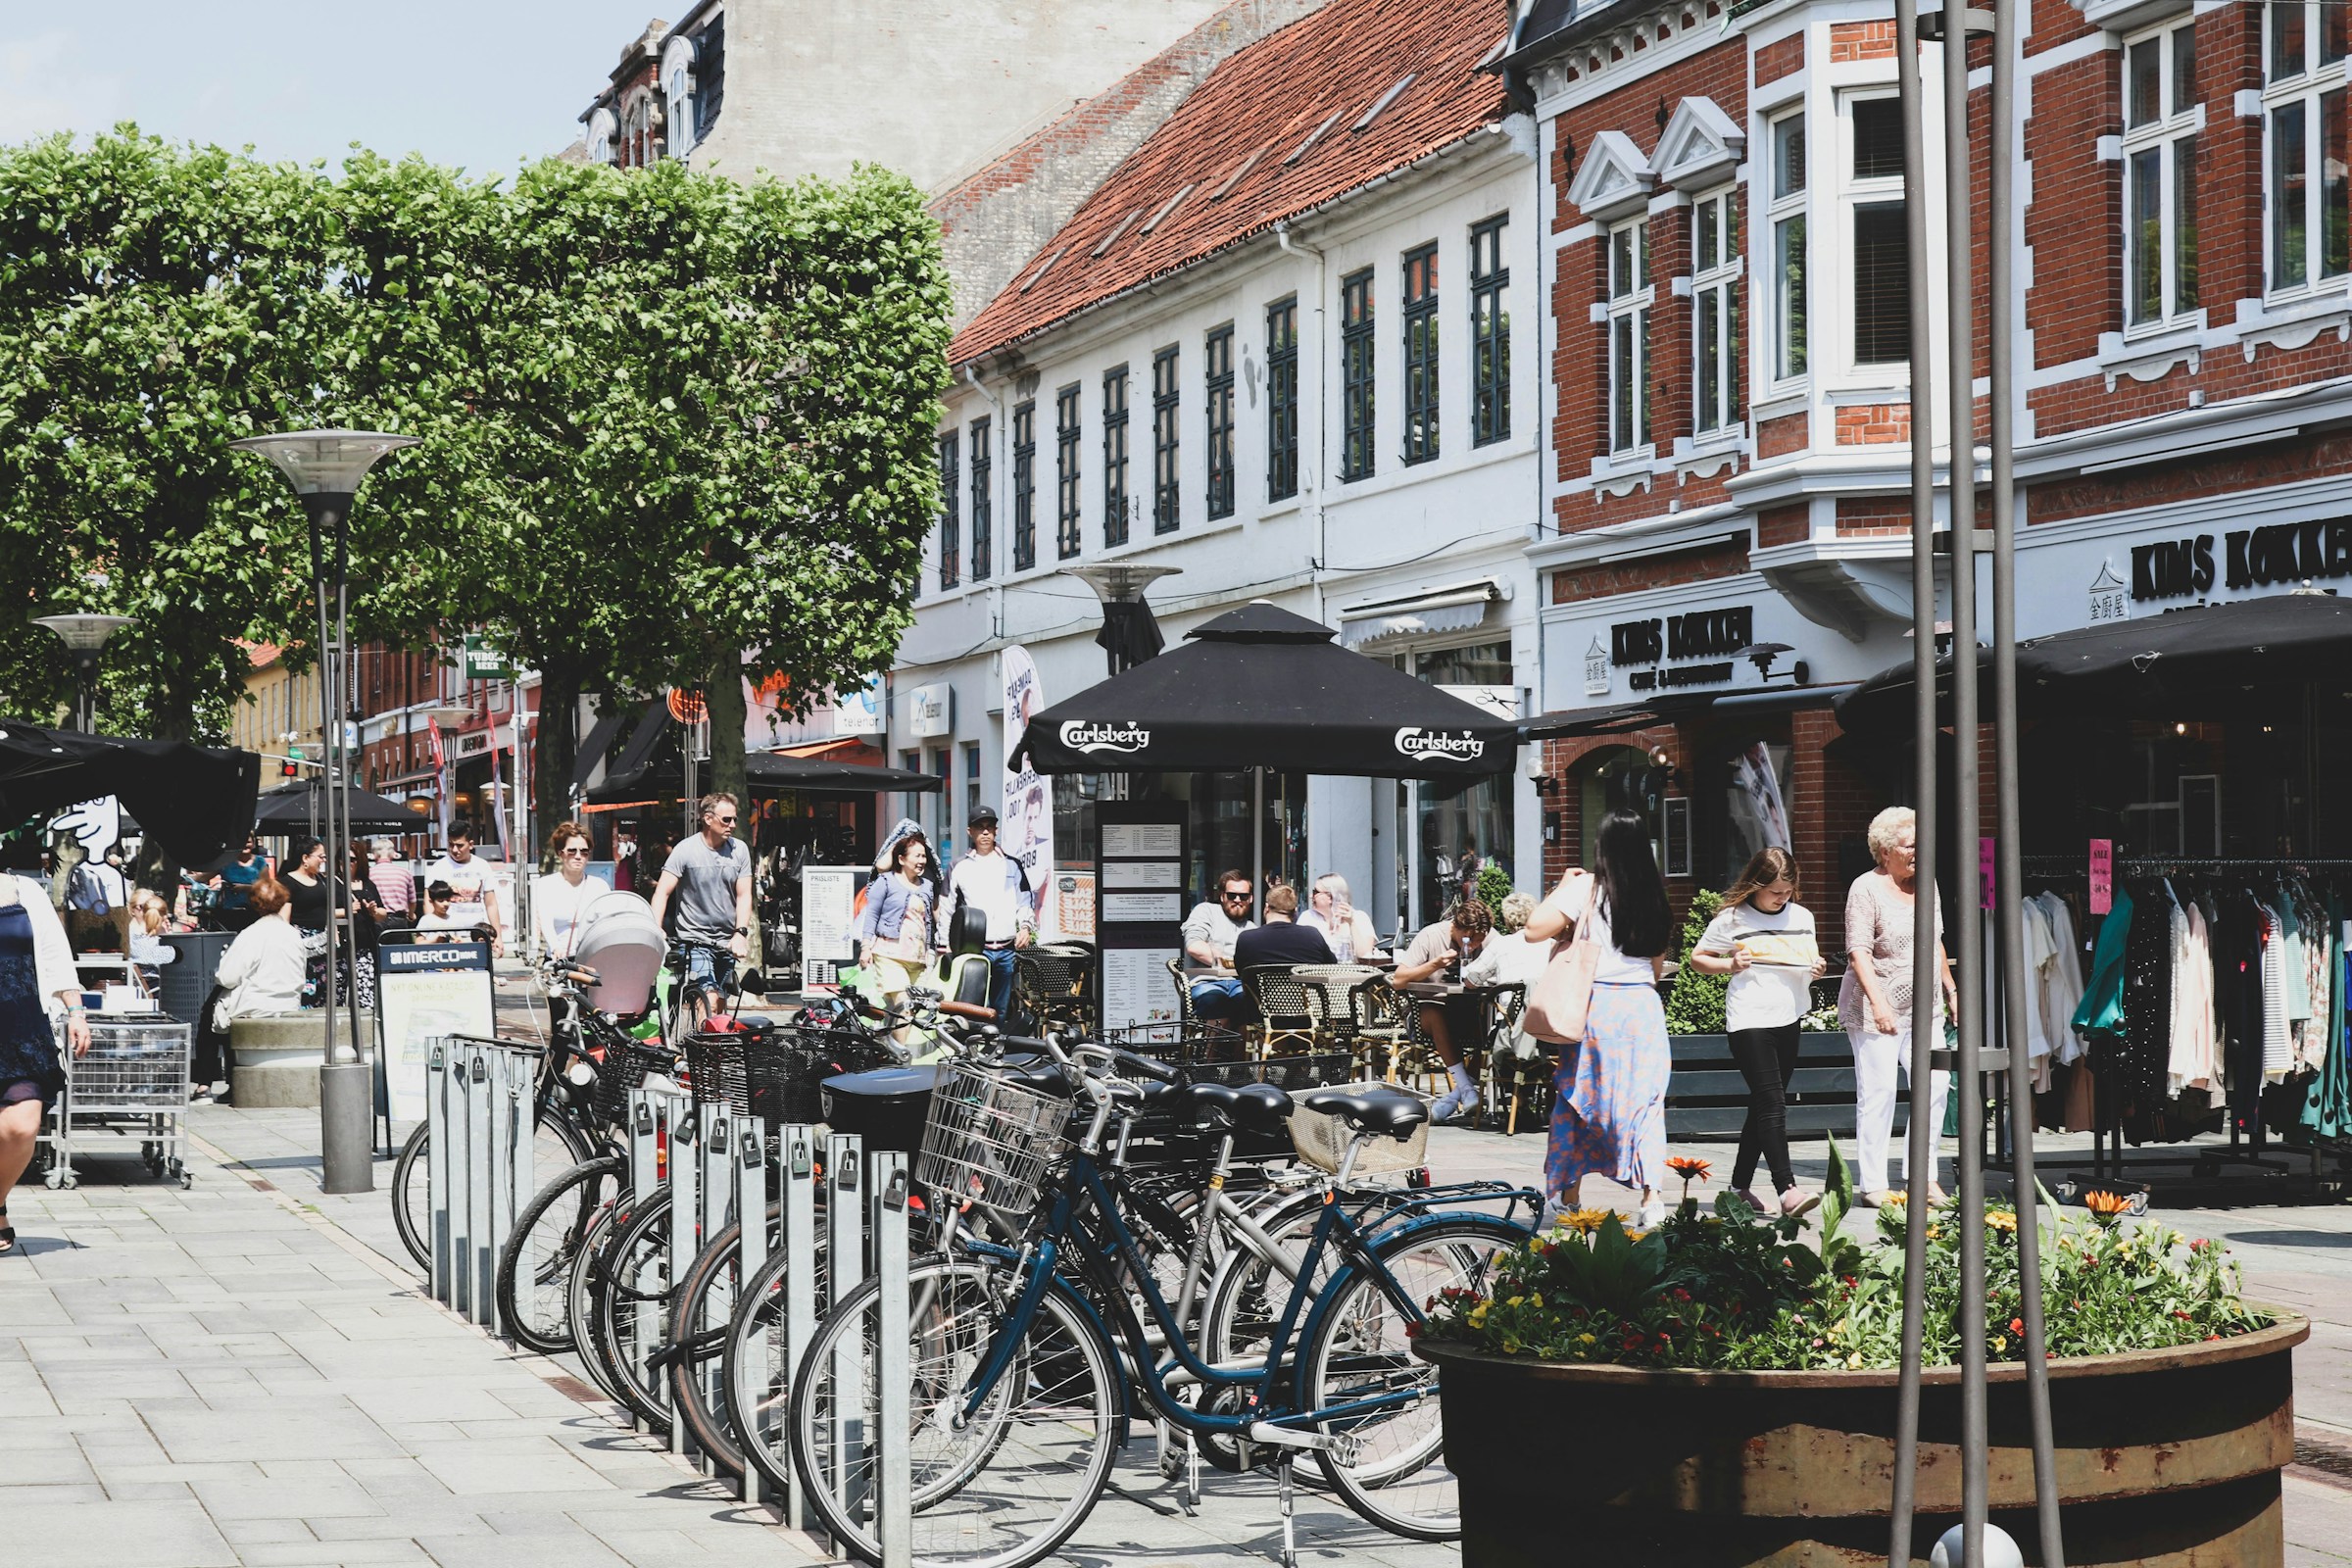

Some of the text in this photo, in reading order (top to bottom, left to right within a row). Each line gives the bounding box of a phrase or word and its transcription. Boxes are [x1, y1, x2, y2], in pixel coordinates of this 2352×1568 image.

[2131, 534, 2216, 603] KIMS
[1611, 617, 1663, 667] KIMS
[474, 662, 500, 670] BEER
[844, 717, 879, 727] telenor
[1059, 719, 1151, 754] Carlsberg
[1395, 726, 1485, 761] Carlsberg
[403, 949, 461, 964] IMERCO
[1193, 1215, 1212, 1264] EVERTON
